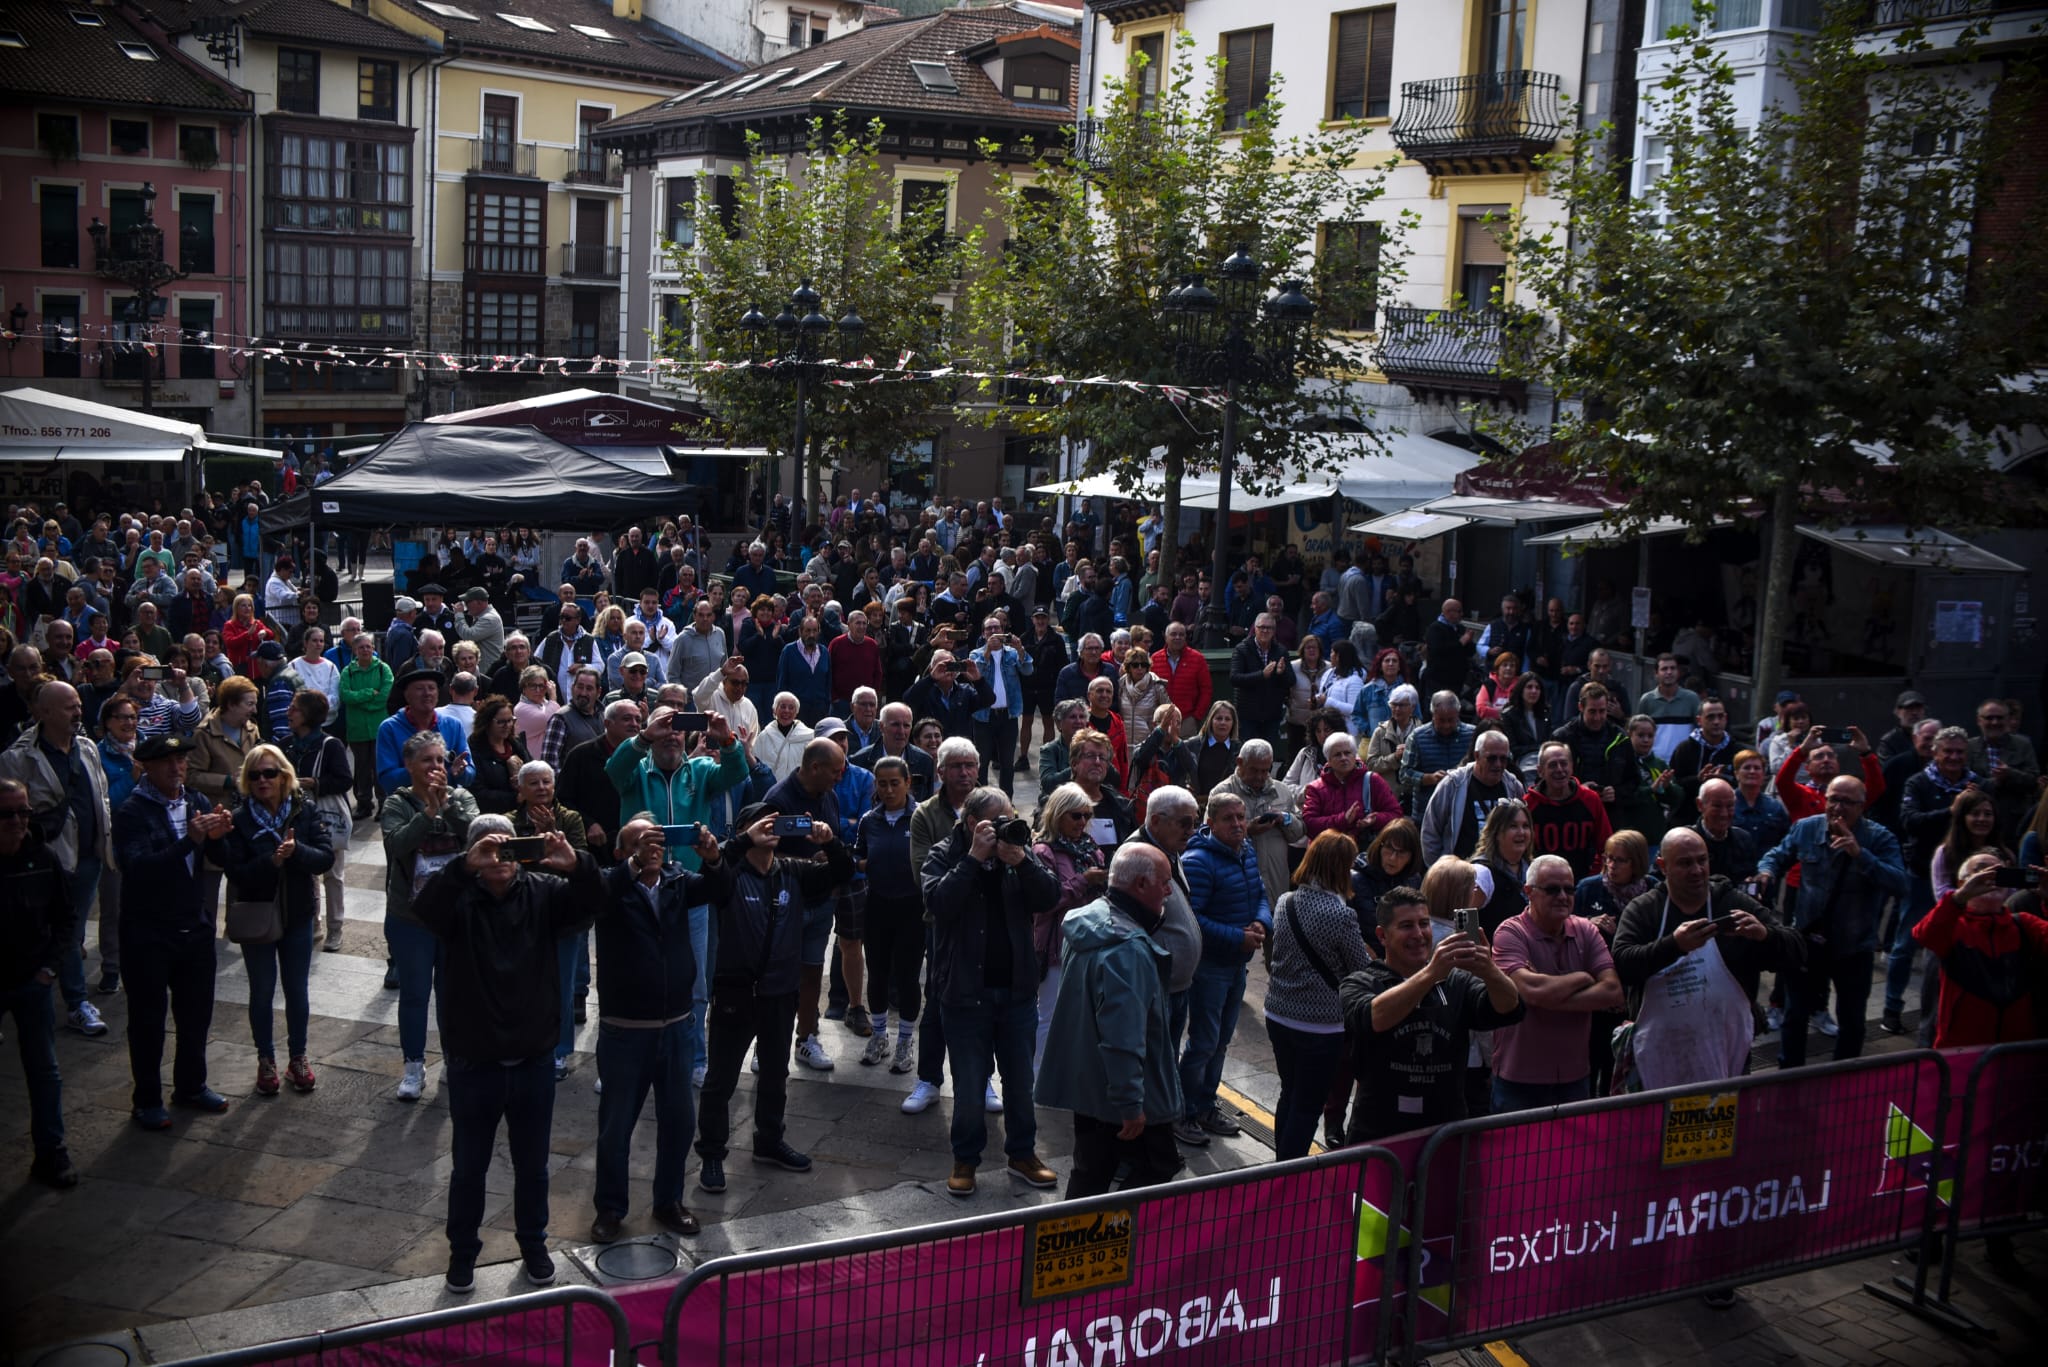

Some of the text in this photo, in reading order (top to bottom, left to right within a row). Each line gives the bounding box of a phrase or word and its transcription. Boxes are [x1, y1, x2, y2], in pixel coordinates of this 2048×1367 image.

[632, 418, 662, 428] JAI-KIT
[2, 425, 111, 438] Tfno.: 656 771 206
[1665, 1134, 1679, 1146] 94
[1682, 1131, 1702, 1143] 635
[1720, 1127, 1733, 1139] 35
[1036, 1261, 1053, 1275] 94
[1058, 1254, 1084, 1271] 635
[1089, 1250, 1105, 1264] 30
[1111, 1246, 1127, 1260] 35
